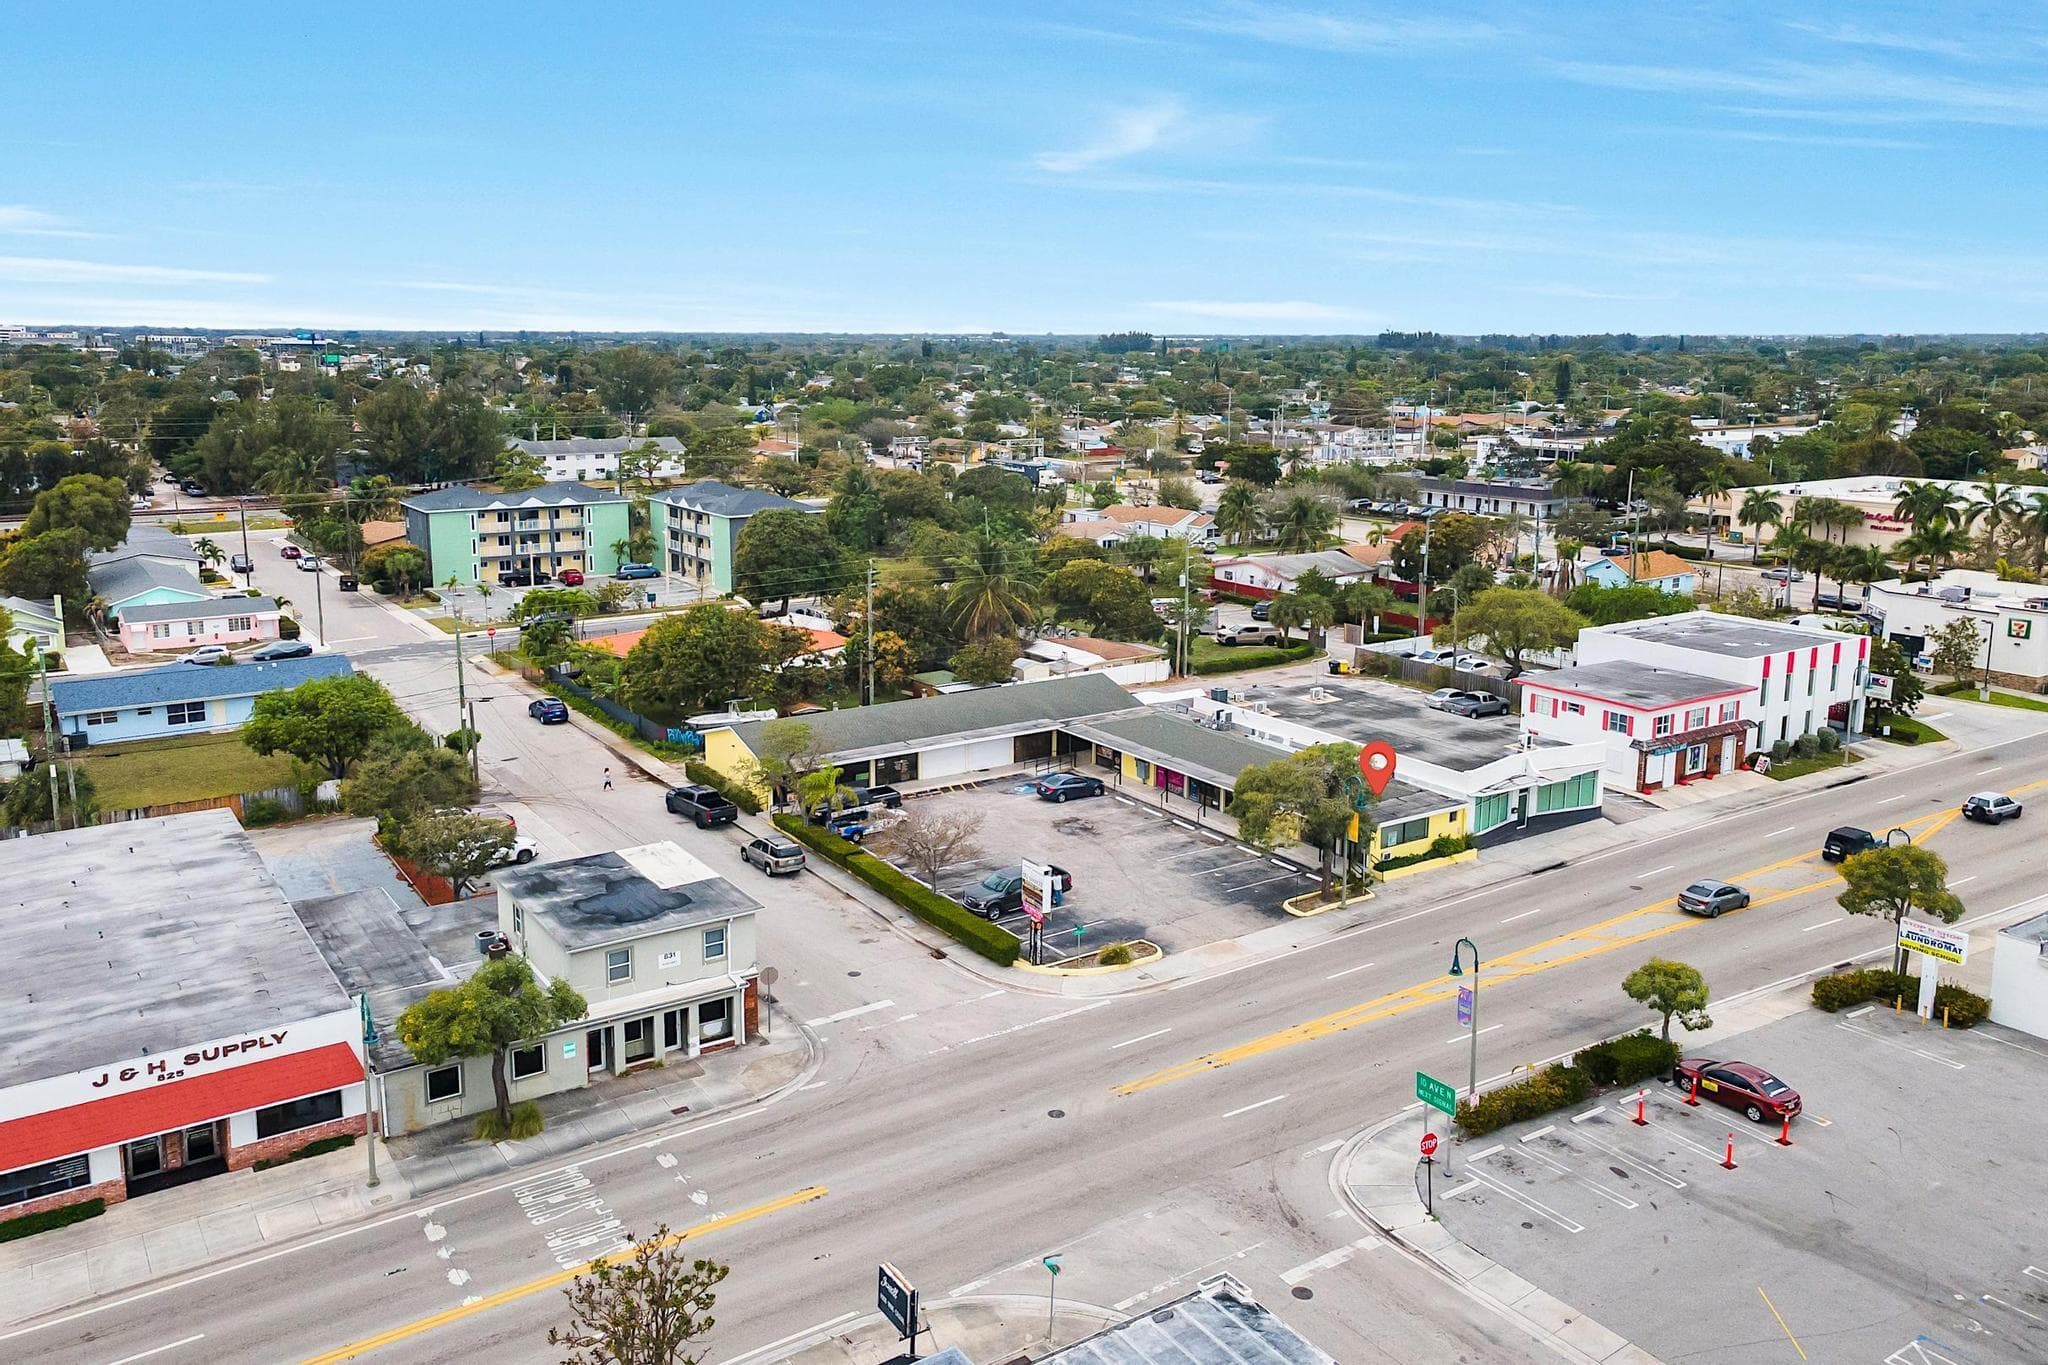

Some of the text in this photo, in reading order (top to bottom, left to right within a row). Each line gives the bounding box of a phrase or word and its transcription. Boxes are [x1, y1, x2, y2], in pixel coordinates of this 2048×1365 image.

[1900, 930, 1963, 954] LAUNDROMAT
[1900, 942, 1929, 955] DRIVING
[1931, 951, 1961, 964] SCHOOL
[92, 1031, 288, 1088] J & H SUPPLY
[157, 1069, 185, 1082] 825
[1418, 1089, 1453, 1112] NEXT SIGNAL
[1429, 1082, 1445, 1097] AVE
[1447, 1091, 1452, 1100] N
[1421, 1139, 1437, 1151] STOP
